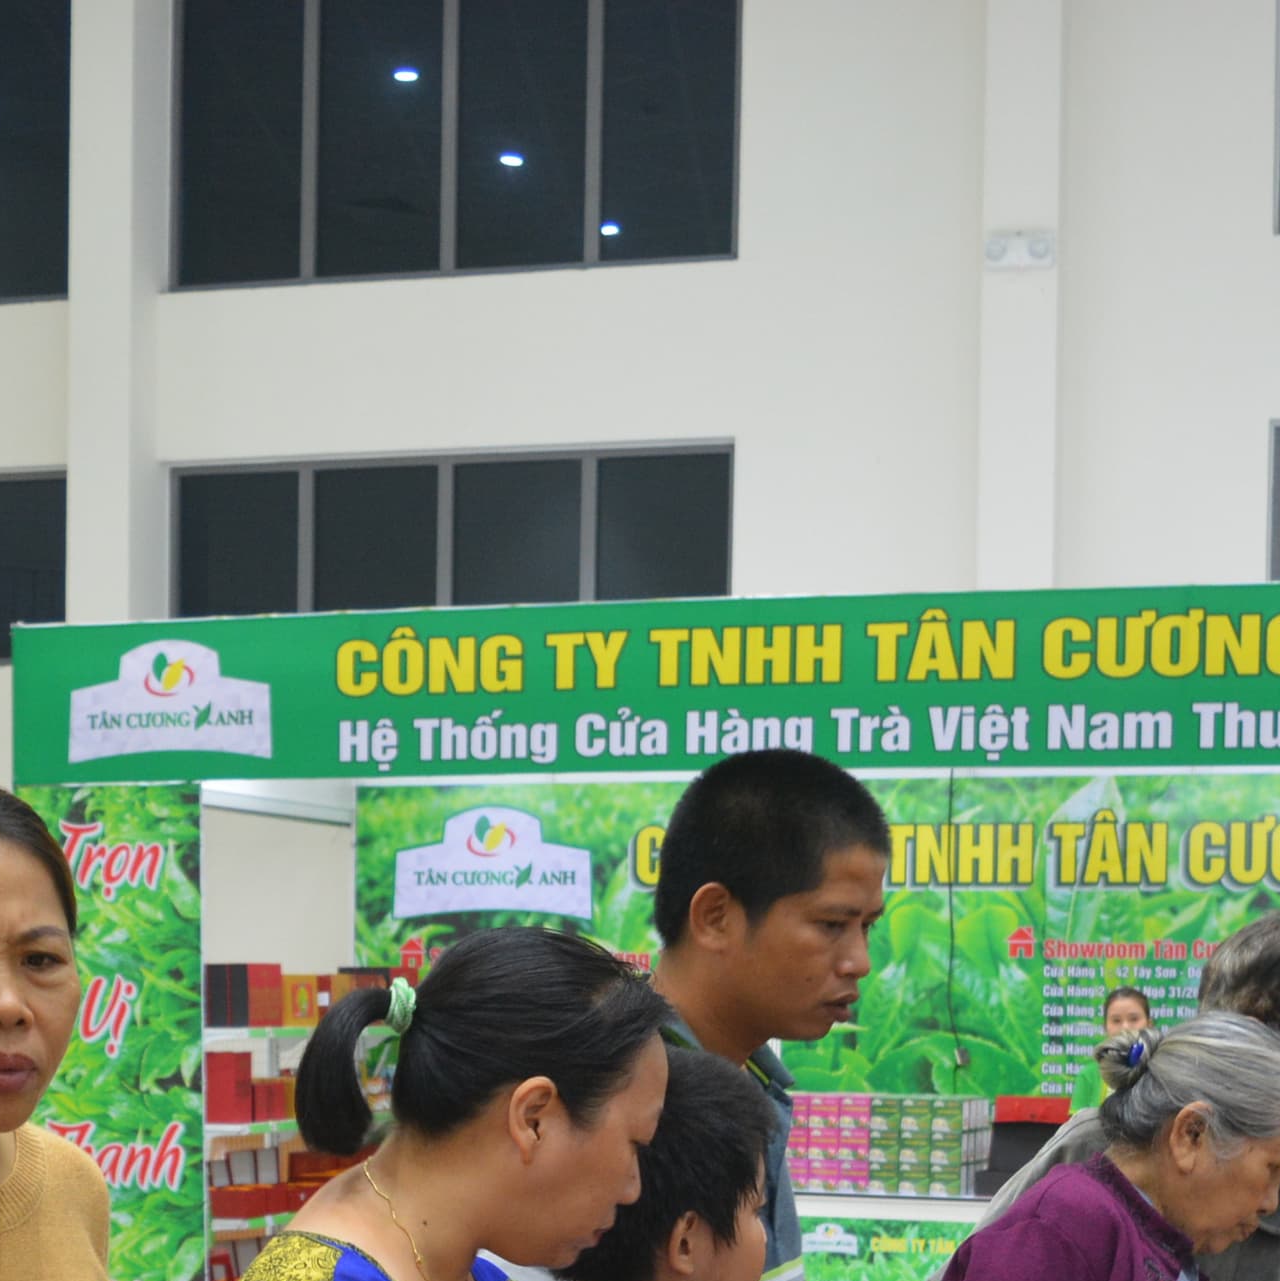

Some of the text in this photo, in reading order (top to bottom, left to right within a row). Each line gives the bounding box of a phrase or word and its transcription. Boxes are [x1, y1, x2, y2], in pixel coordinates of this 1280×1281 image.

[336, 625, 524, 697] CÔNG
[545, 630, 629, 690] TY
[648, 624, 842, 687] TNHH
[866, 607, 1016, 682] TÂN
[87, 710, 122, 730] TÂN
[338, 718, 398, 772] Hệ
[413, 709, 558, 764] Thống
[575, 706, 669, 757] Cửa
[685, 708, 814, 754] Hàng
[830, 705, 911, 752] Trà
[928, 703, 1030, 761] Việt
[1047, 703, 1173, 751] Nam
[60, 821, 164, 899] Trọn
[888, 822, 1035, 885] TNHH
[1051, 807, 1168, 886] TÂN
[1043, 939, 1147, 960] Showroom
[78, 974, 137, 1058] Vị
